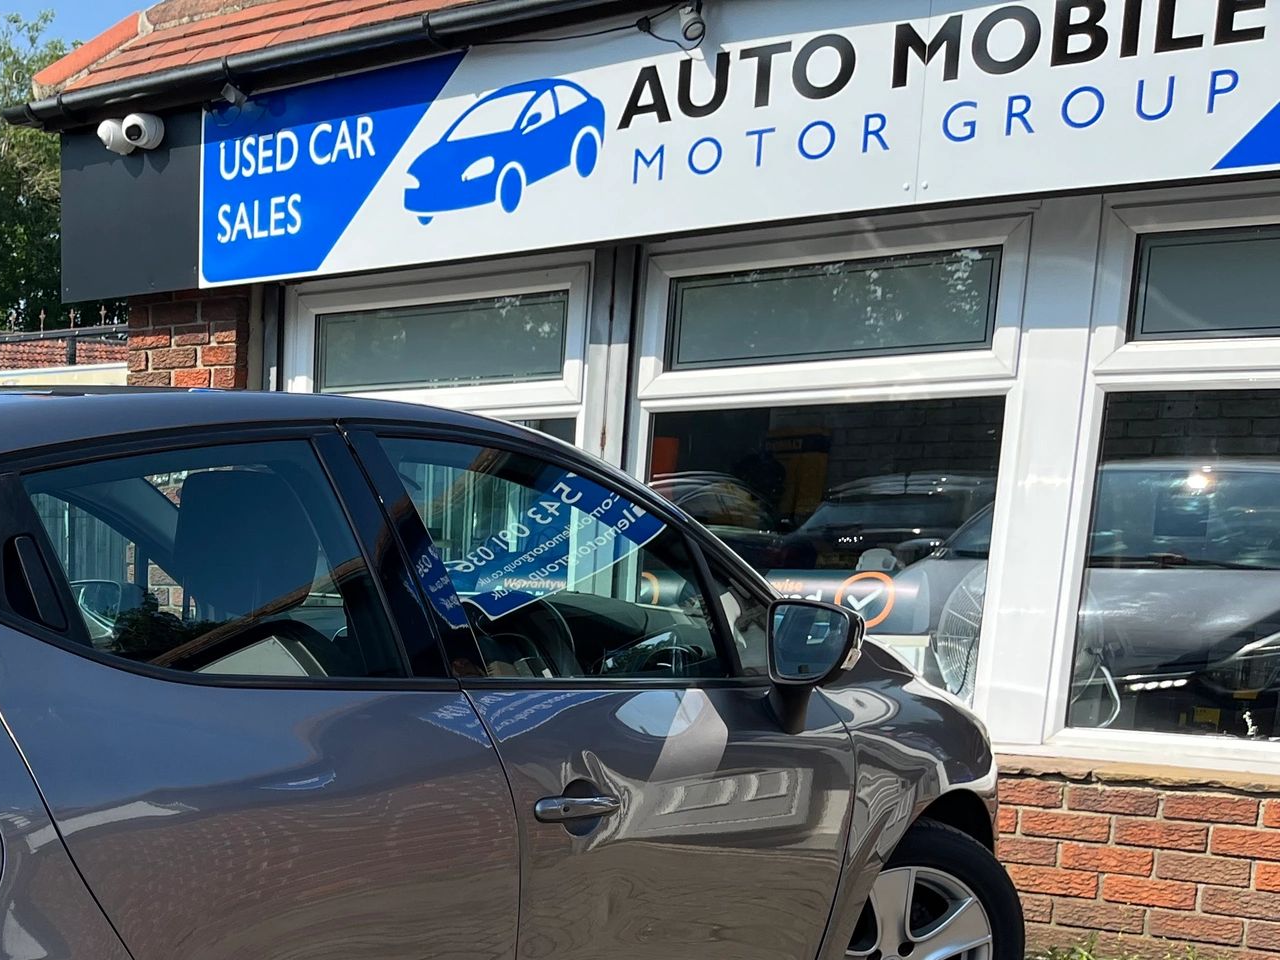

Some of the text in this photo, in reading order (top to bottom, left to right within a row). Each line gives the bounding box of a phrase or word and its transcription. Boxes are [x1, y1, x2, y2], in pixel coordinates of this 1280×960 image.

[617, 0, 1266, 130] AUTO MOBILE
[219, 116, 376, 181] USED CAR
[634, 69, 1239, 184] MOTOR GROUP
[217, 193, 302, 243] SALES
